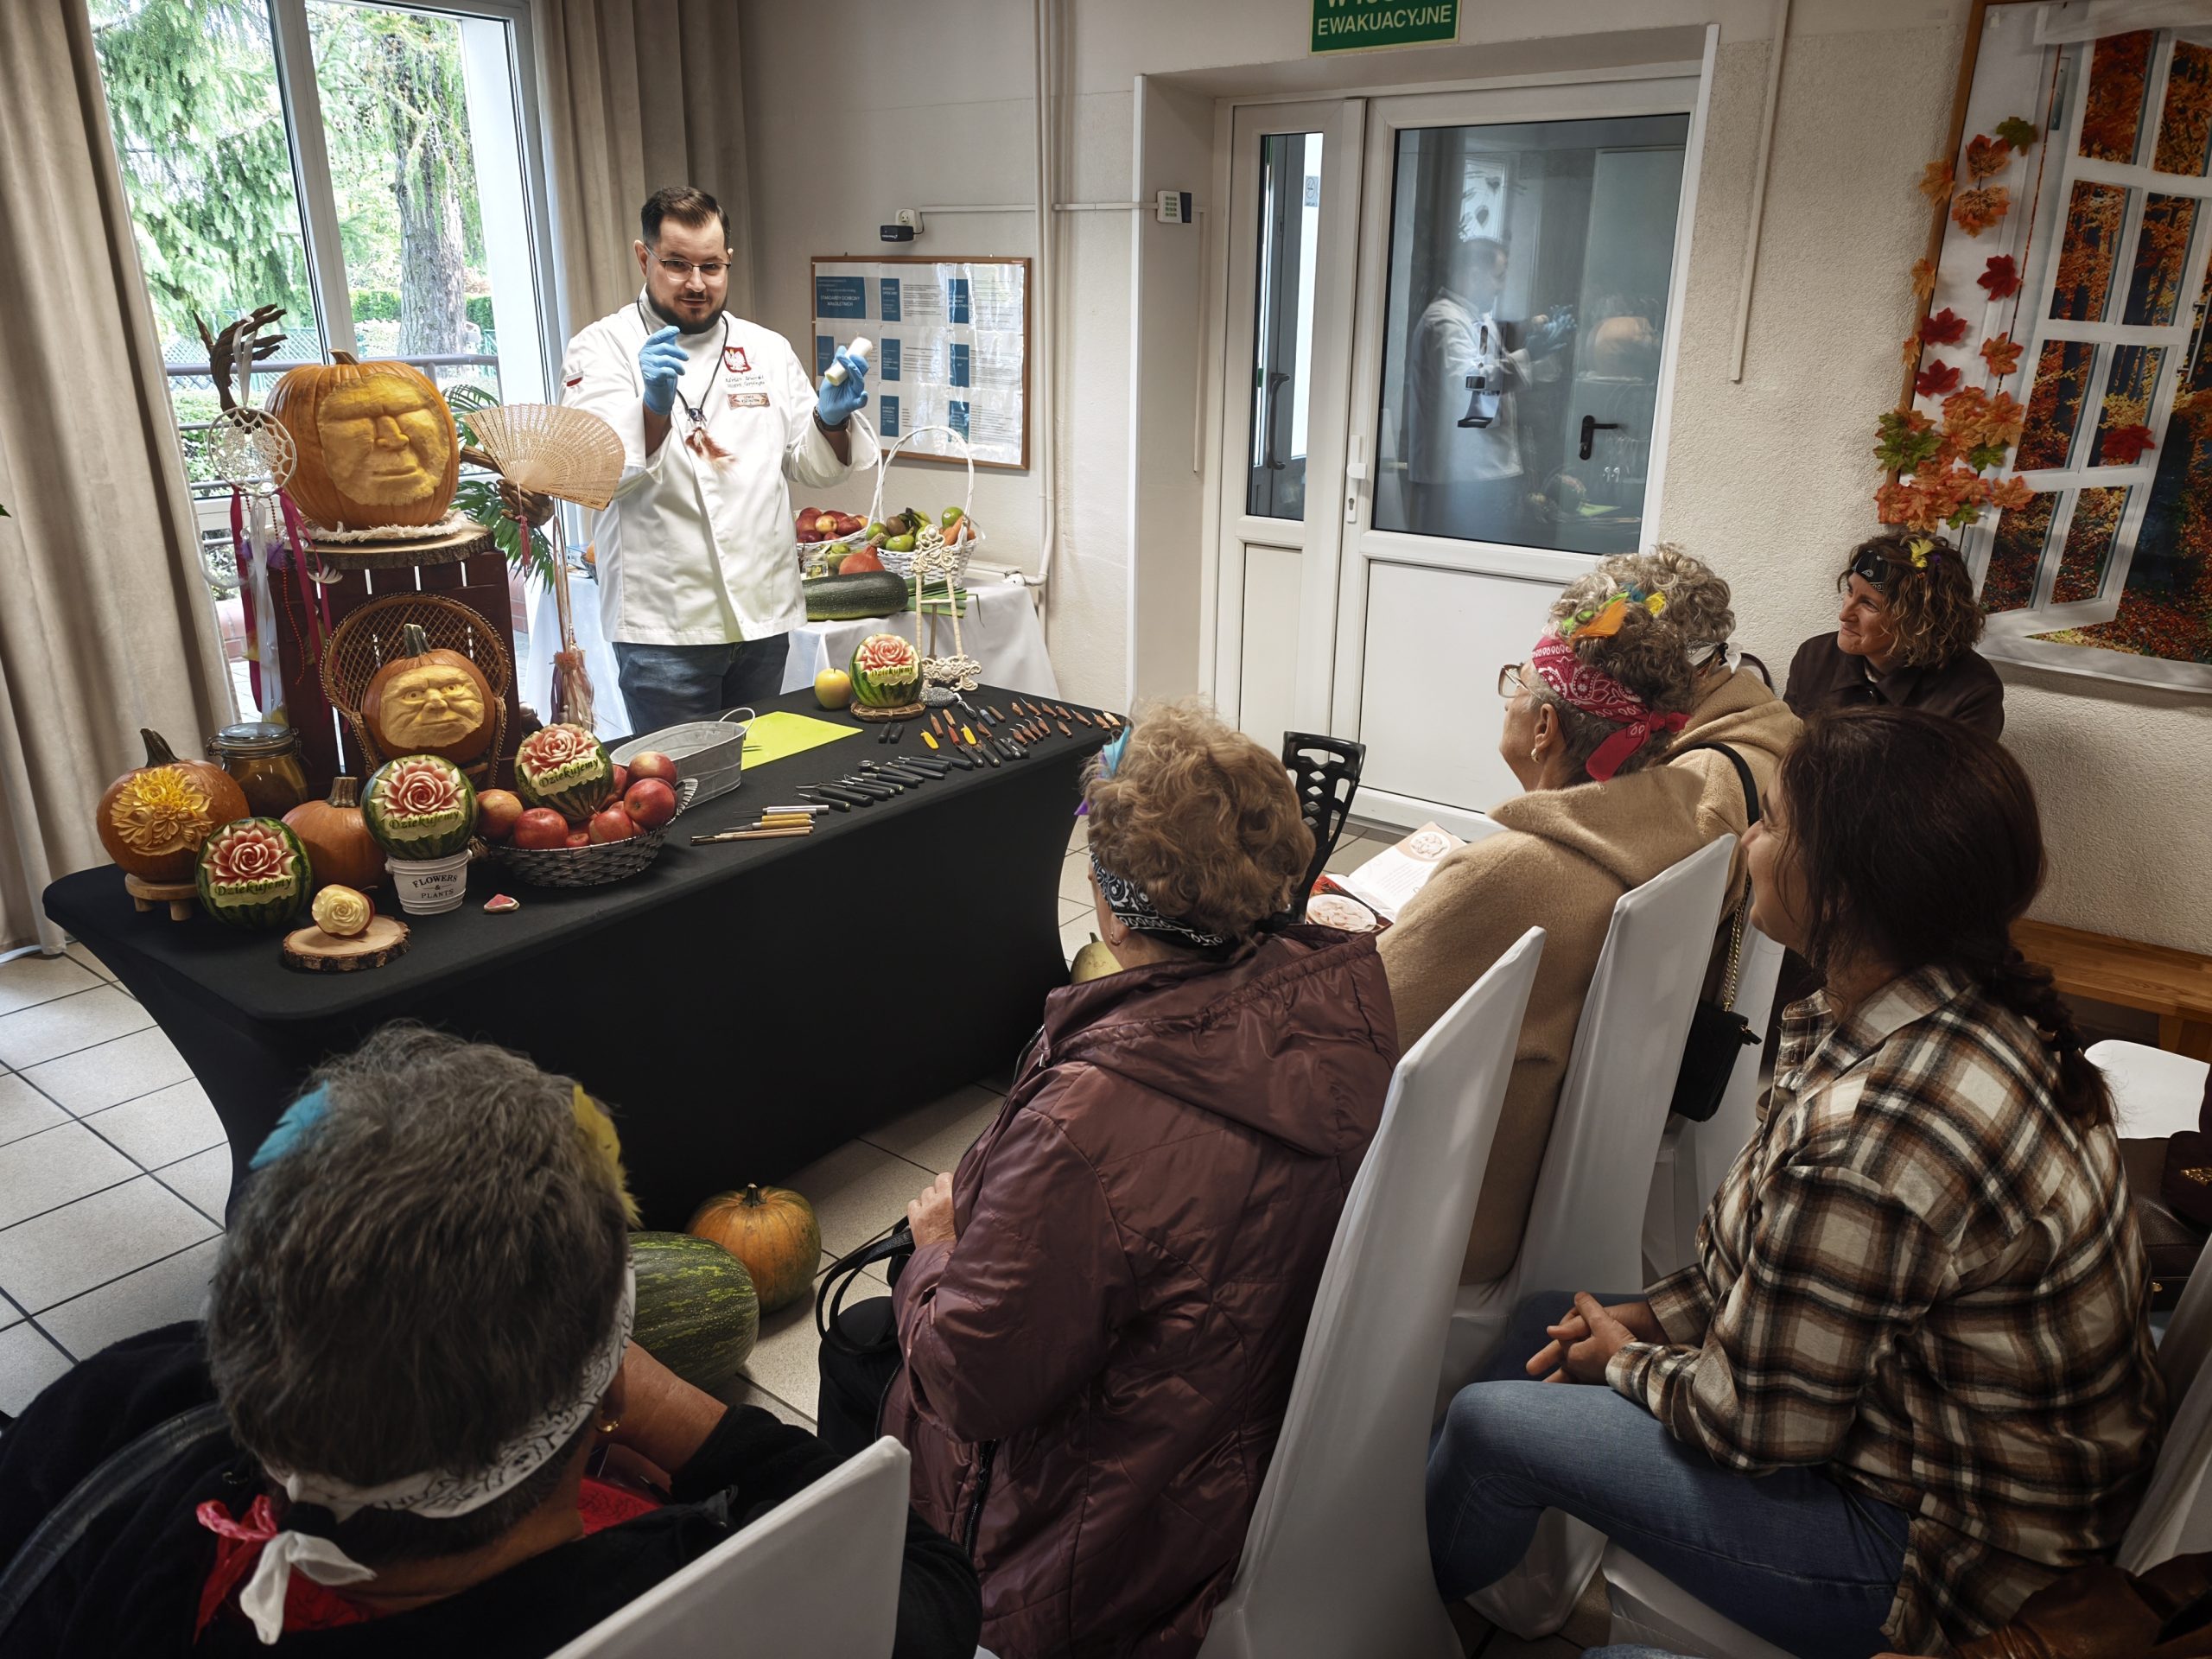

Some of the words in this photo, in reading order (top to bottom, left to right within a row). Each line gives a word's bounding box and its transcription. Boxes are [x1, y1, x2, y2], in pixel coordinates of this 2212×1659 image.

[1318, 4, 1452, 35] EWAKUACYJNE
[412, 874, 458, 888] FLOWERS
[421, 888, 454, 899] PLANTS
